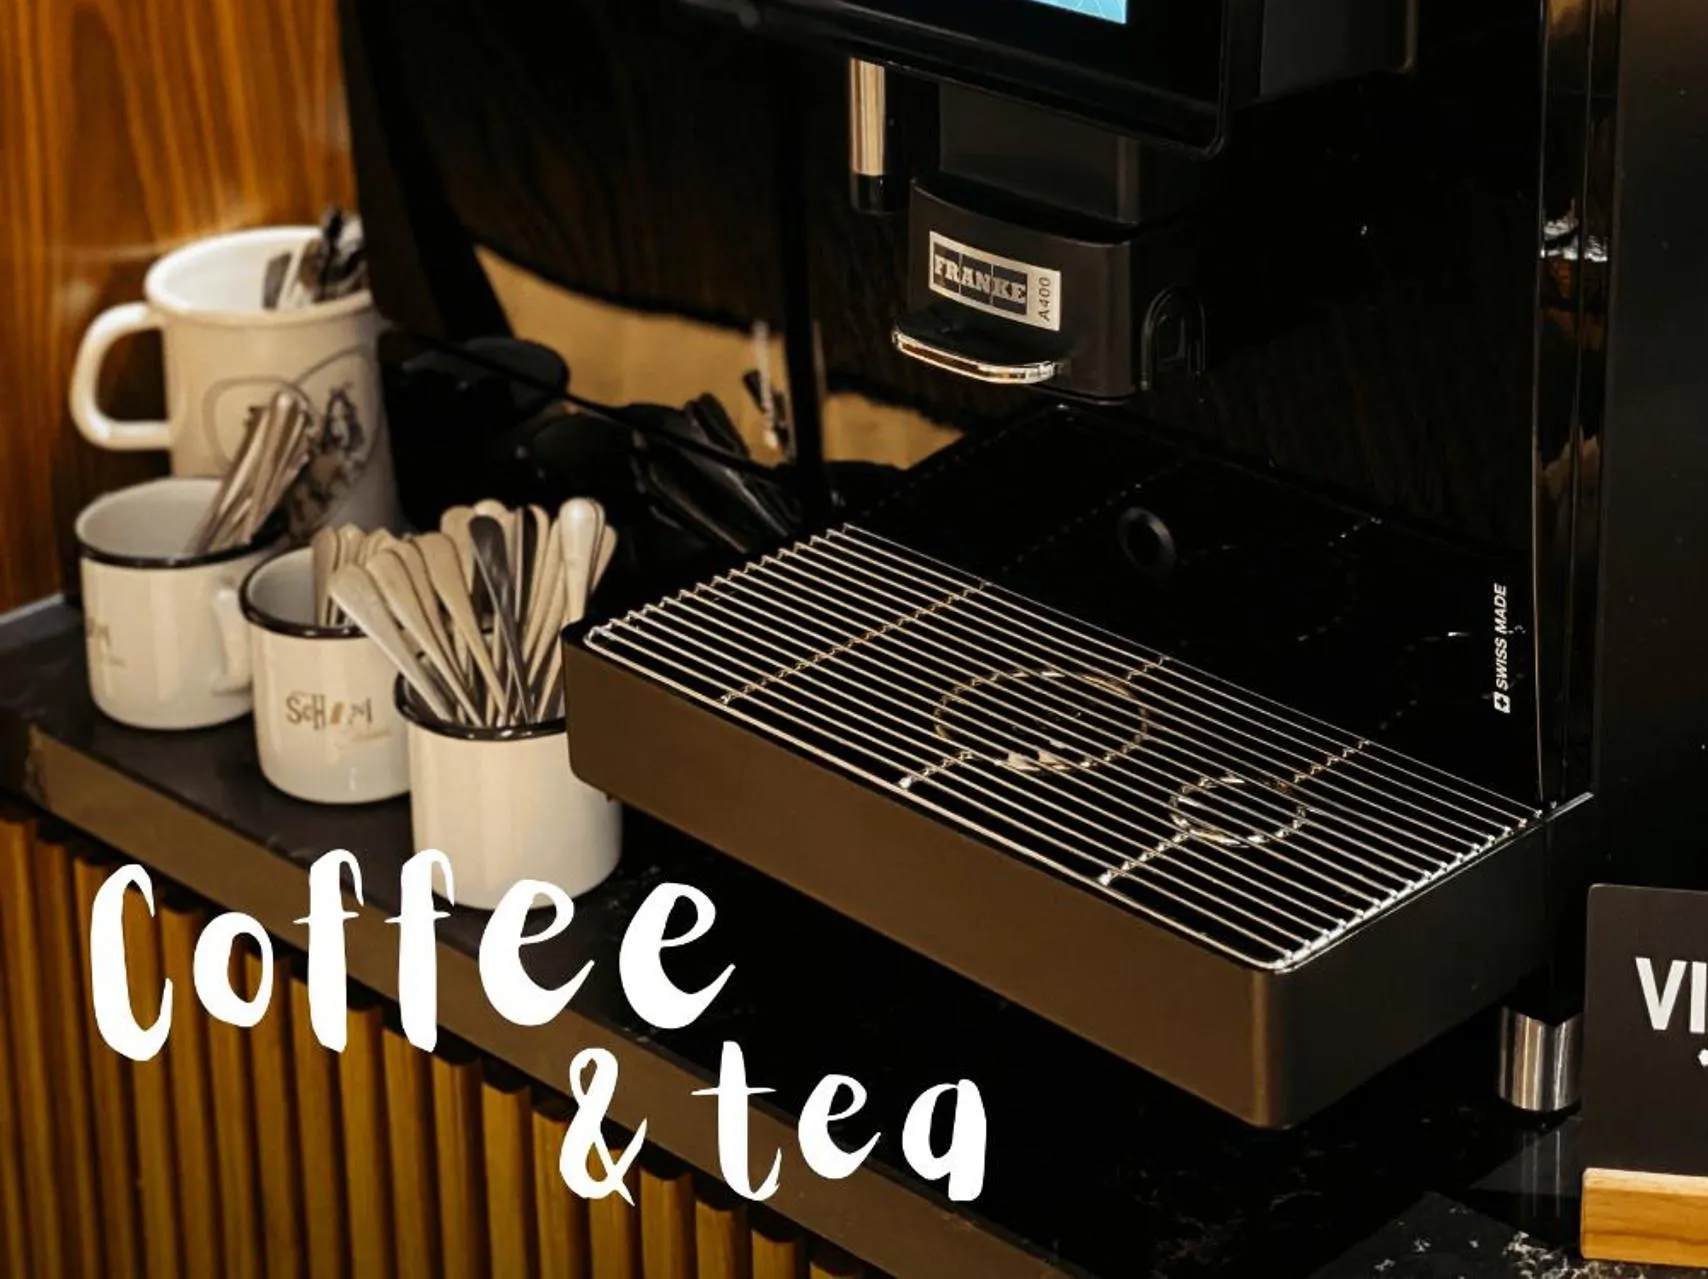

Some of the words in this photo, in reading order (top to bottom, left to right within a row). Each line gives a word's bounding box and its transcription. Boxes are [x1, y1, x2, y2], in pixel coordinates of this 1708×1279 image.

[934, 255, 1027, 304] FRANKE
[1038, 276, 1051, 322] A400
[1493, 582, 1507, 635] MADE
[1494, 637, 1509, 691] SWISS
